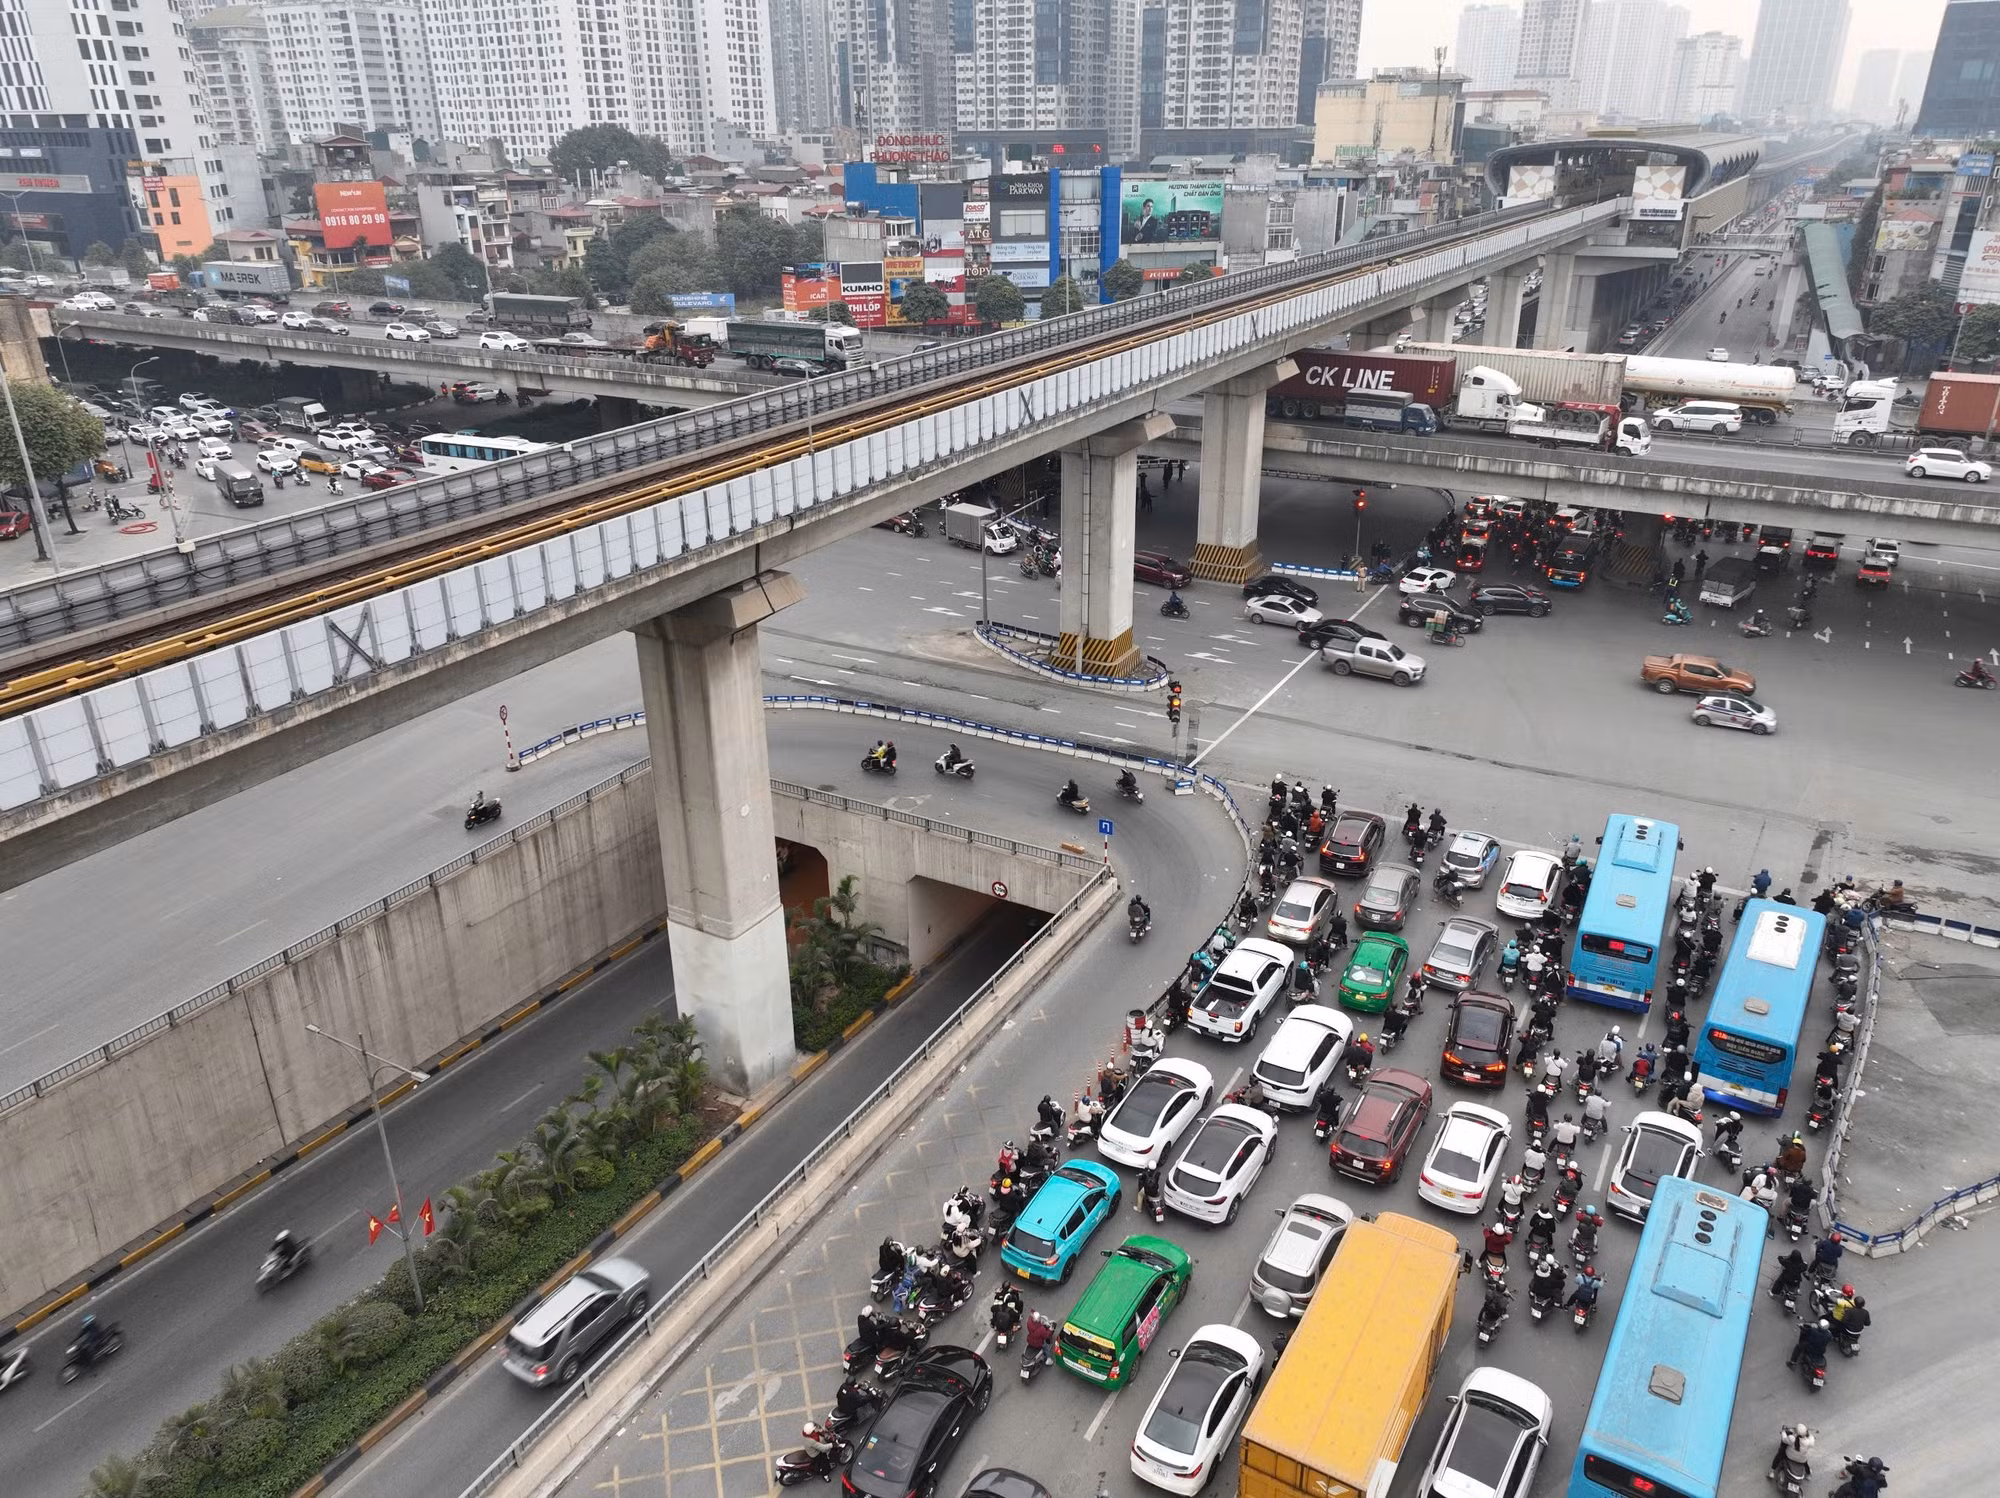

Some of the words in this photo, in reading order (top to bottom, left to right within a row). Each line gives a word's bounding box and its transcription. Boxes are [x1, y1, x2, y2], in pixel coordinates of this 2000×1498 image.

[1009, 186, 1044, 194] PARKWAY
[325, 215, 347, 226] 0916
[349, 214, 360, 225] 80
[362, 214, 373, 224] 20
[374, 213, 385, 223] 99
[968, 230, 990, 239] ATG
[965, 267, 992, 275] TOPY
[221, 271, 262, 285] MAERSK
[842, 285, 883, 293] KUMHO
[1305, 365, 1339, 387] CK
[1342, 367, 1395, 390] LINE
